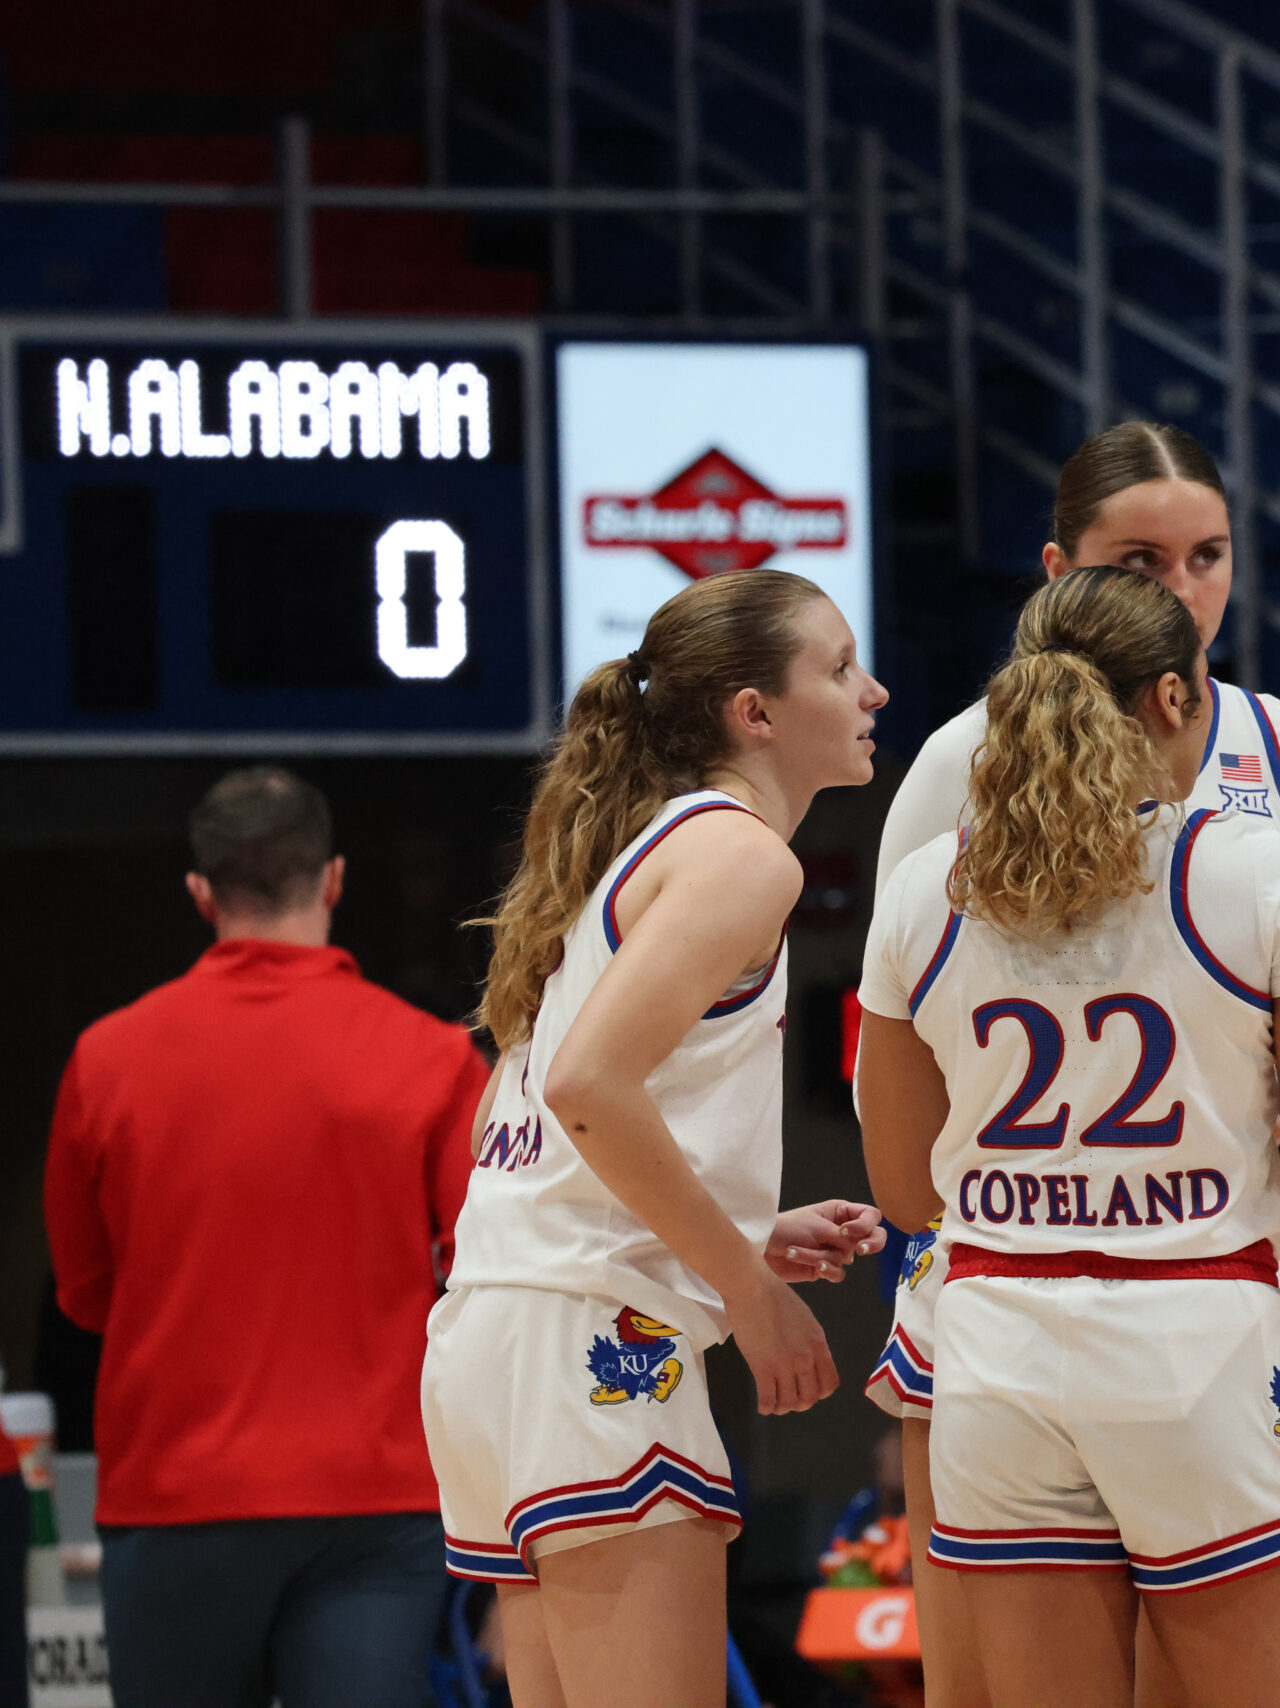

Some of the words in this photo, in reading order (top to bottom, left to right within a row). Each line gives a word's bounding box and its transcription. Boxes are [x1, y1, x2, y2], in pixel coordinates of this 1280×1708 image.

[58, 359, 490, 458] N.ALABAMA
[375, 519, 467, 679] 0
[972, 993, 1185, 1150] 22
[959, 1168, 1230, 1226] COPELAND
[618, 1354, 648, 1375] KU
[855, 1597, 909, 1650] G
